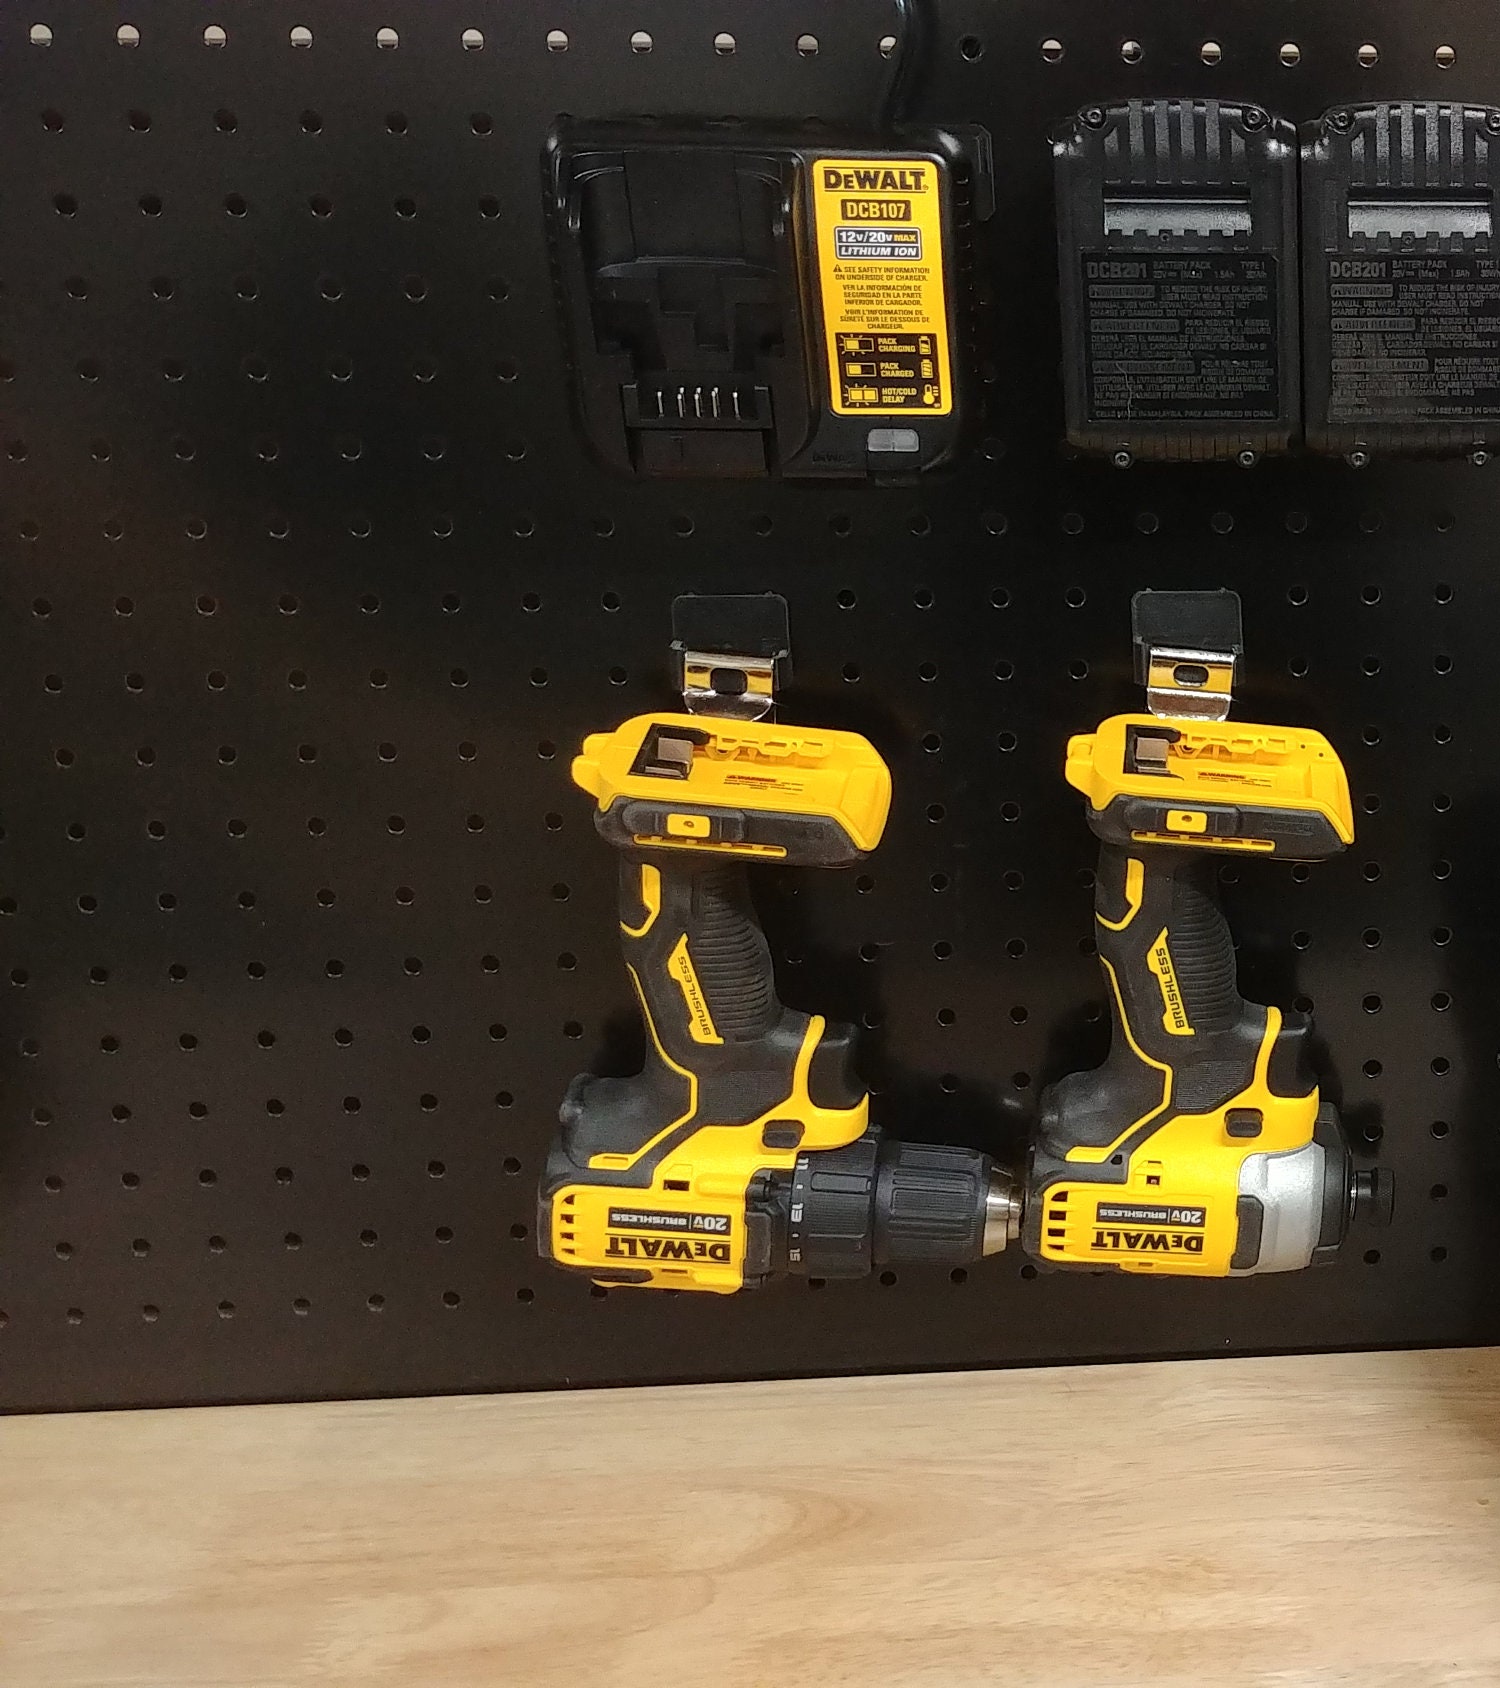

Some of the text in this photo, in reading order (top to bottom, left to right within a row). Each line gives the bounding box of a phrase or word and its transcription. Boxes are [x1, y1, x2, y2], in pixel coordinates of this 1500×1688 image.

[846, 201, 907, 218] DCB107
[894, 233, 917, 242] MAX
[840, 246, 918, 256] LITHIUM ION
[1087, 261, 1147, 278] DCB201
[1153, 260, 1211, 270] BATTERY PACK
[1240, 260, 1260, 270] TYPE
[1330, 261, 1386, 278] DCB201
[1392, 260, 1448, 269] BATTERY PACK
[1476, 260, 1495, 269] TYPE
[858, 266, 883, 274] SAFETY
[884, 267, 931, 275] INFORMATION
[877, 337, 897, 345] PACK
[878, 345, 916, 353] CHARGING
[879, 362, 899, 370] PACK
[880, 369, 915, 378] CHARGED
[881, 387, 917, 396] HOT/COLD
[882, 395, 905, 403] DELAY
[1155, 946, 1186, 1029] BRUSHLESS
[678, 955, 712, 1037] BRUSHLESS
[790, 1202, 804, 1223] 13
[1098, 1208, 1167, 1221] BRUSHLESS
[610, 1211, 687, 1227] BRUSHLESS
[789, 1247, 801, 1262] 15
